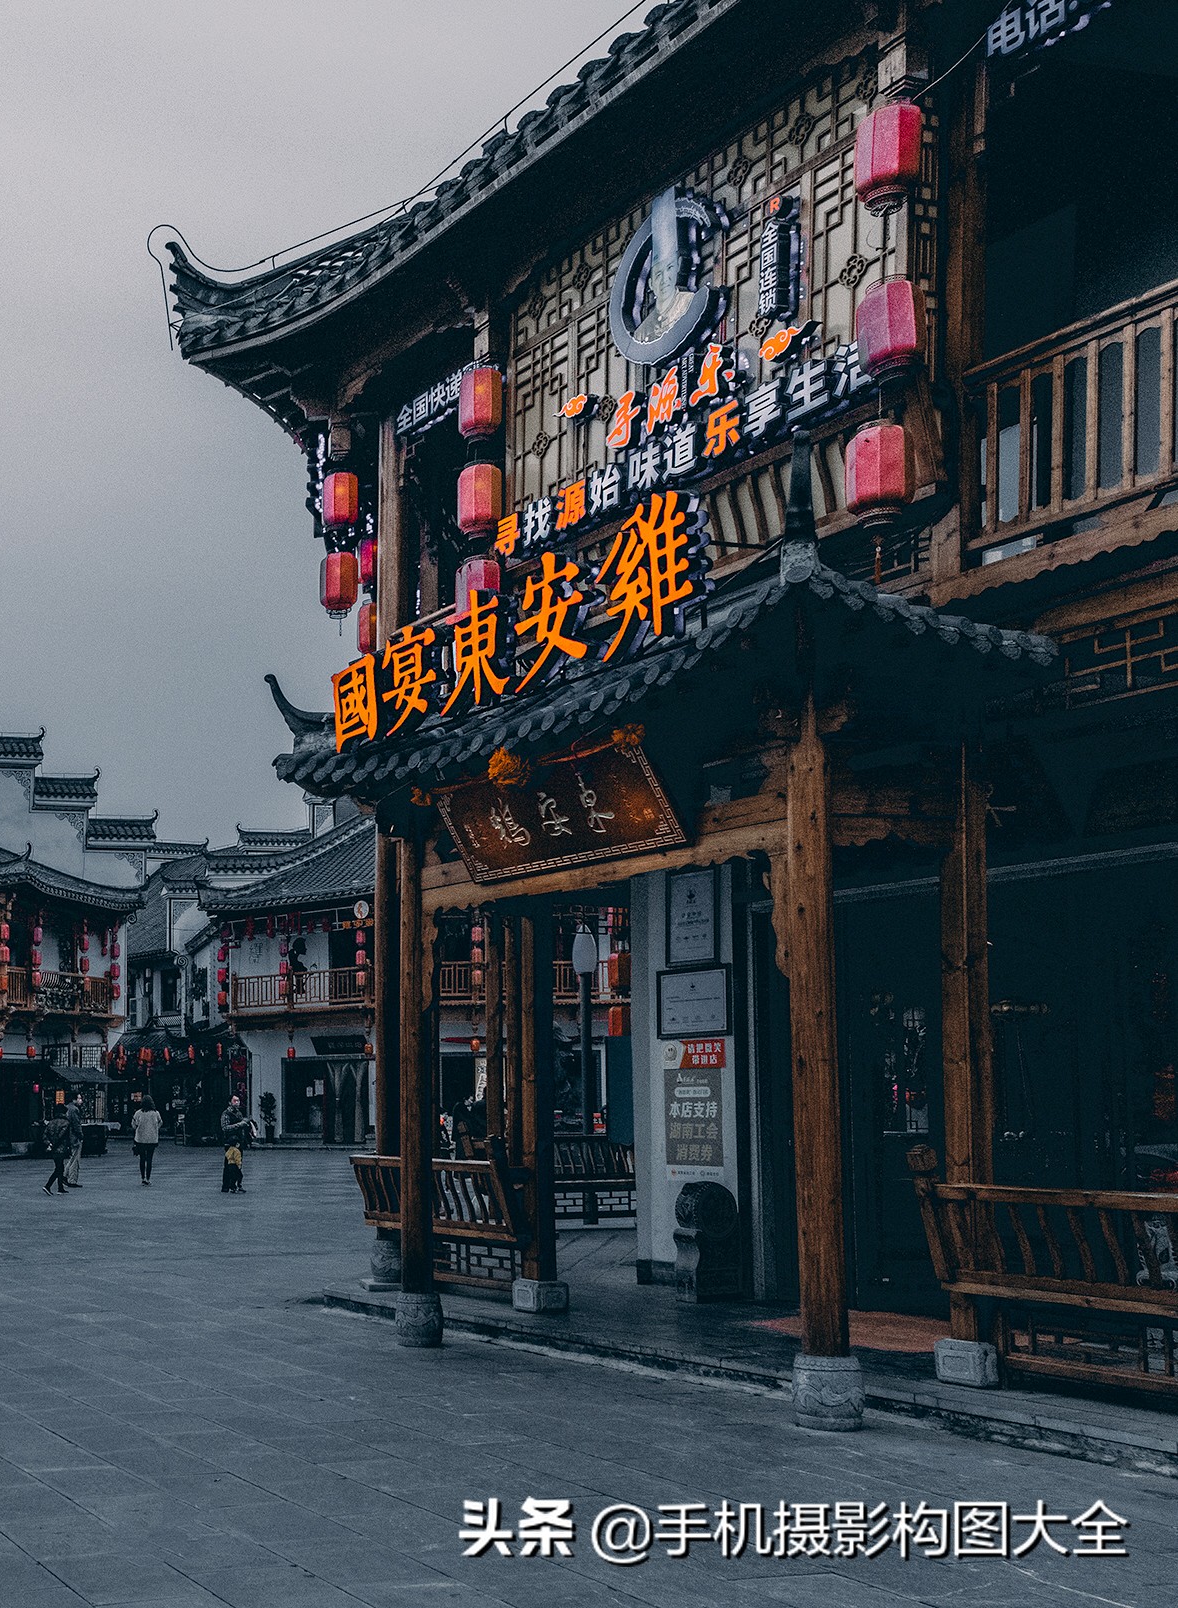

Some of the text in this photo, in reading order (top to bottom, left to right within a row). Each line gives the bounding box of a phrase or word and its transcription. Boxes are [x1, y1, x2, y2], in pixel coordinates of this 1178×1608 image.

[759, 219, 779, 316] 全国连锁
[396, 358, 492, 435] 全国快递
[669, 1101, 718, 1118] 本店支持
[669, 1122, 719, 1139] 湖南工会
[676, 1143, 714, 1161] 消费券
